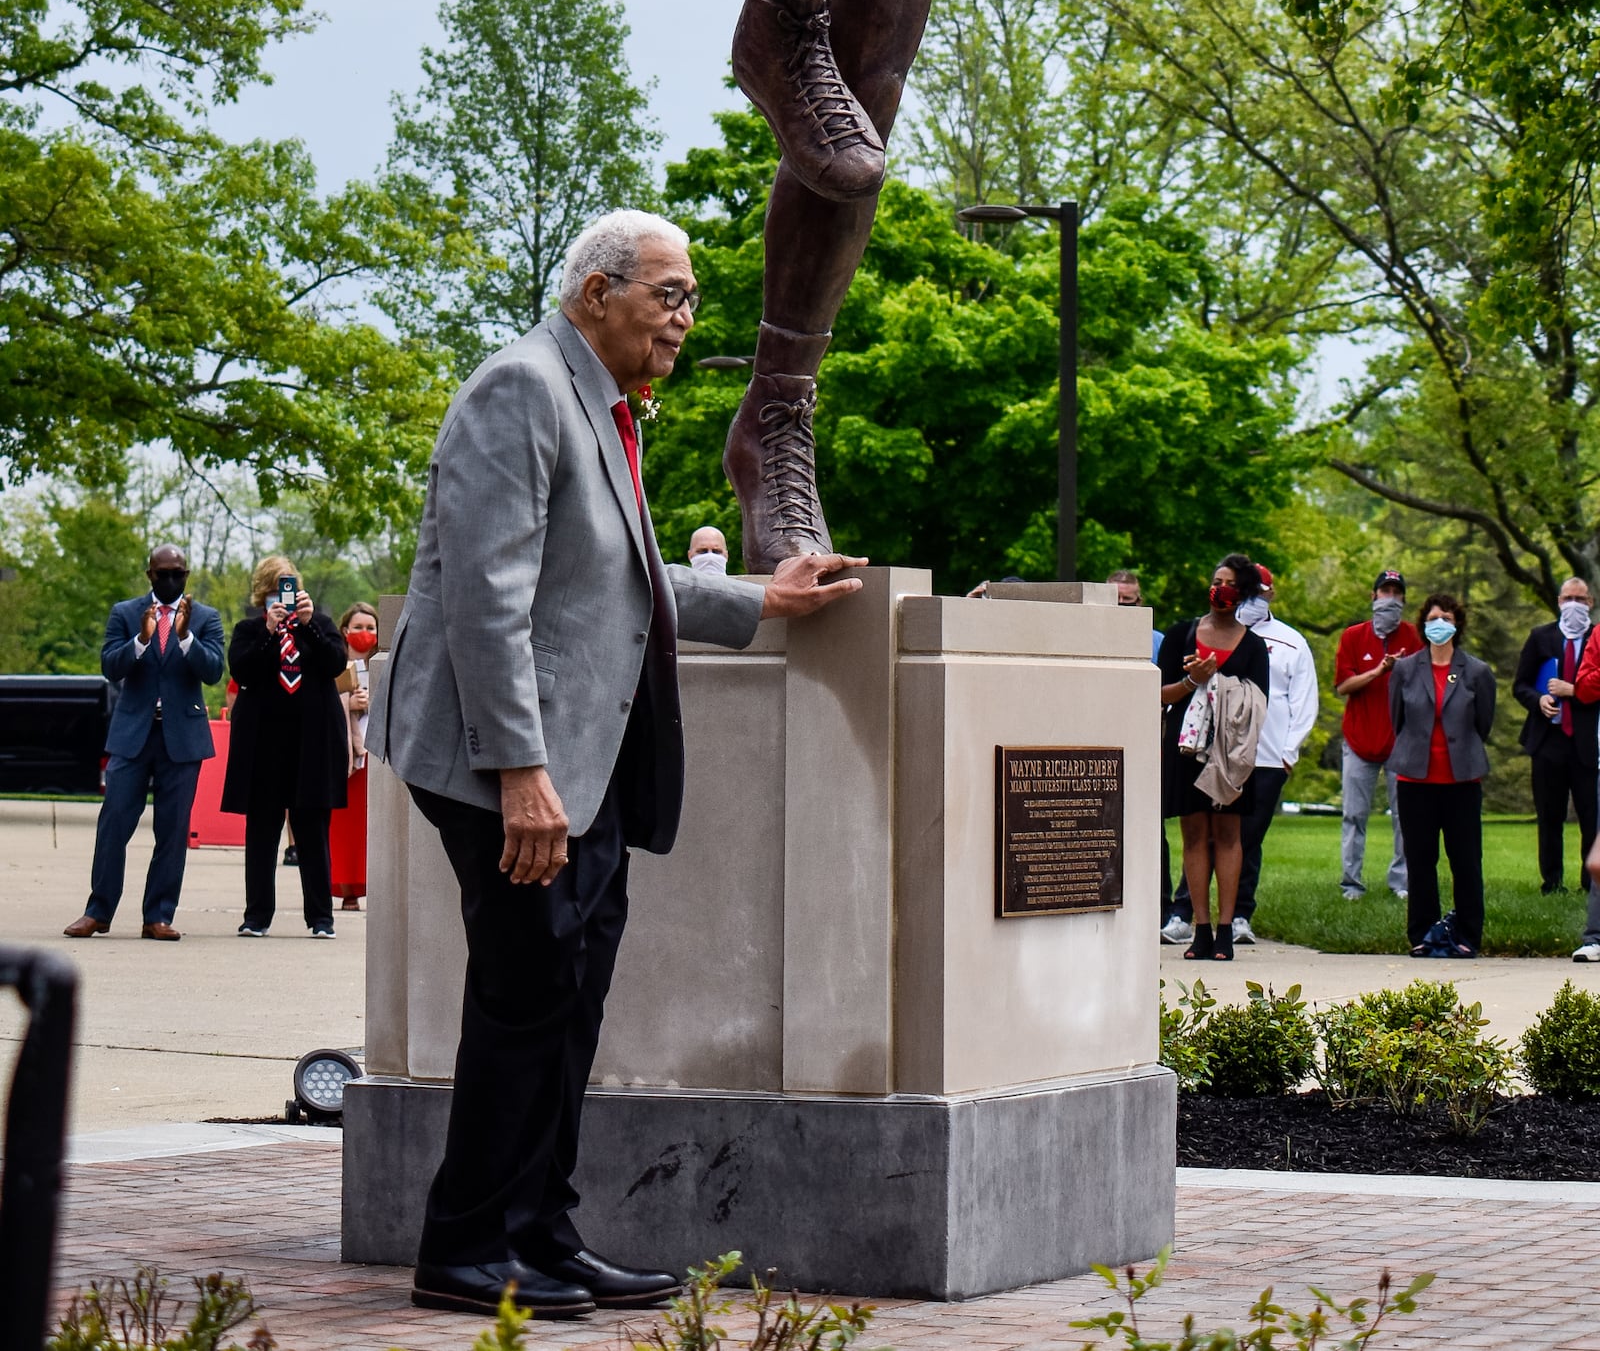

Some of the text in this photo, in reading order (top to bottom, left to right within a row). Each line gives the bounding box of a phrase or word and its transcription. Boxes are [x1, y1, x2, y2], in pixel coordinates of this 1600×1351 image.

[1009, 759, 1119, 778] WAYNE RICHARD EMBRY
[1009, 780, 1031, 793] MIAMI
[1031, 779, 1071, 793] UNIVERSITY
[1071, 779, 1092, 792] CLASS
[1092, 779, 1101, 791] OF
